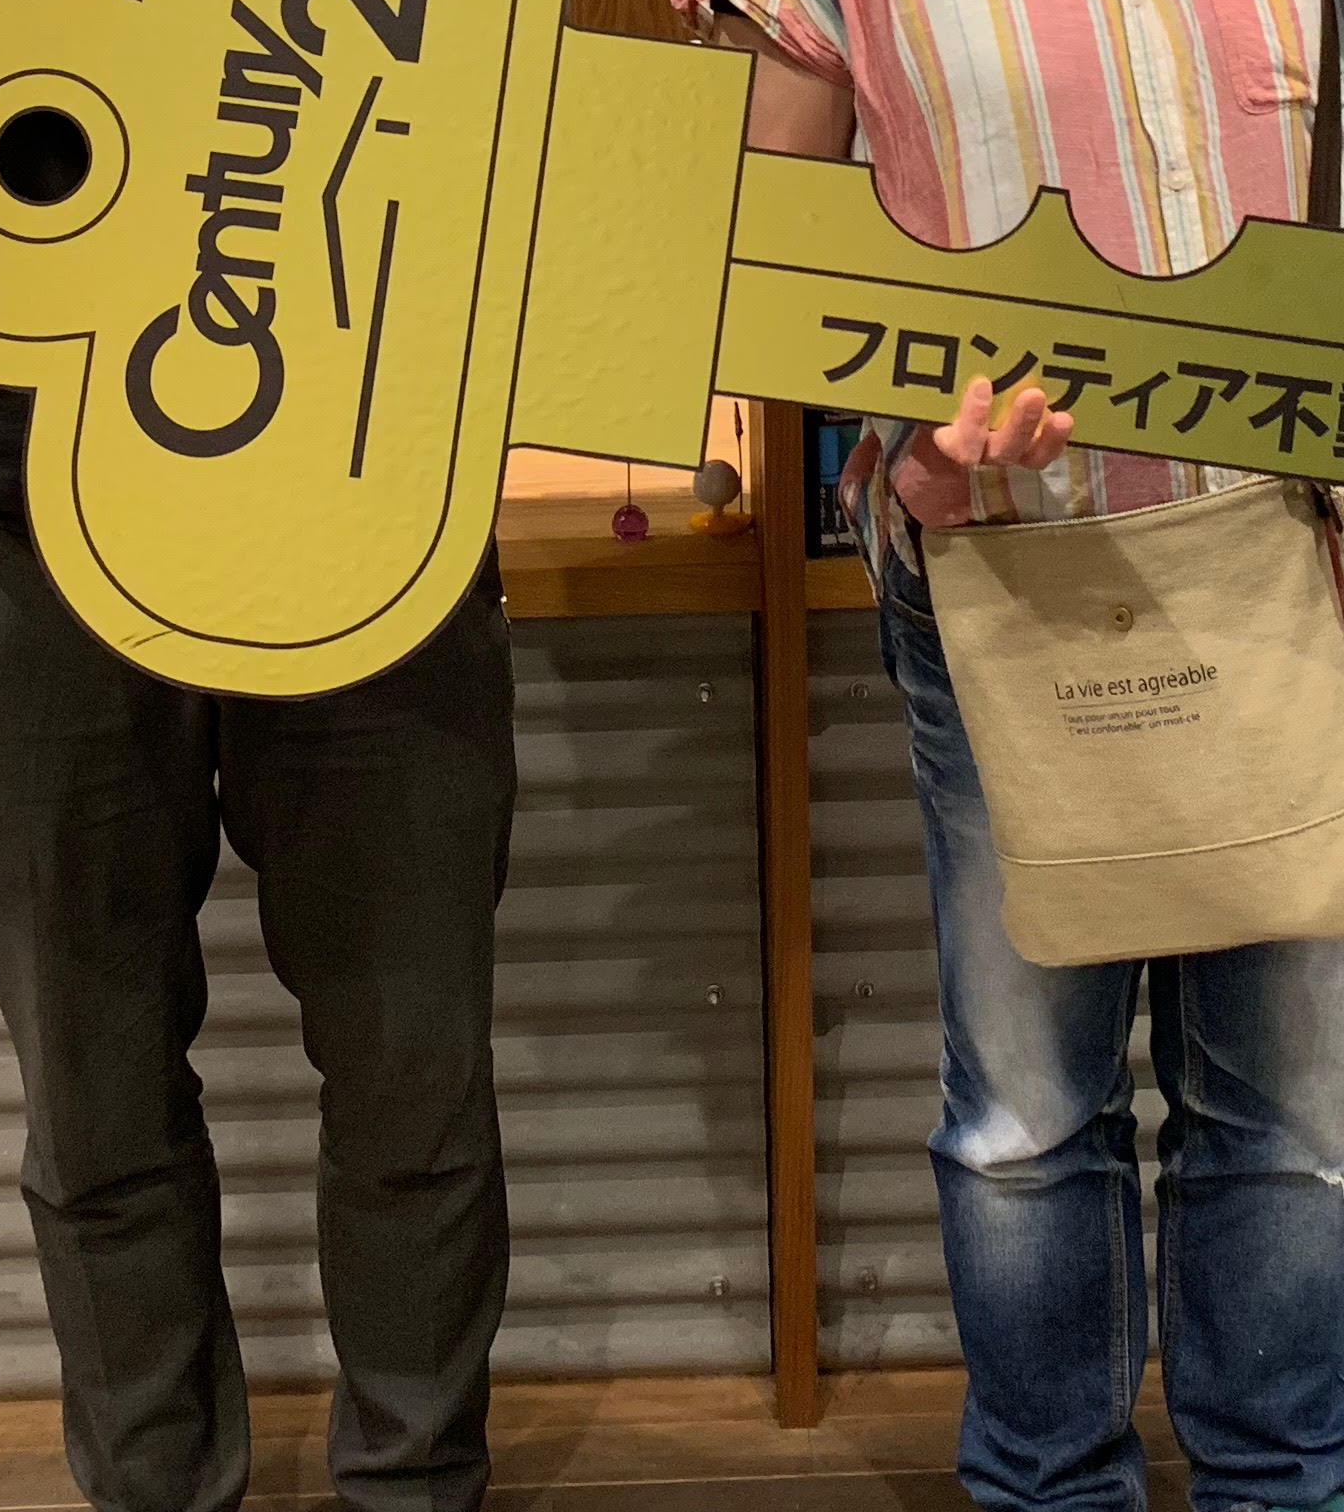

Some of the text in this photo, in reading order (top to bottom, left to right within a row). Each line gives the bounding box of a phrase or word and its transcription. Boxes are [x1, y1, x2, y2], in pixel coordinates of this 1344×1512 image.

[1055, 680, 1075, 701] La
[1077, 679, 1104, 699] vie
[1107, 678, 1134, 697] est
